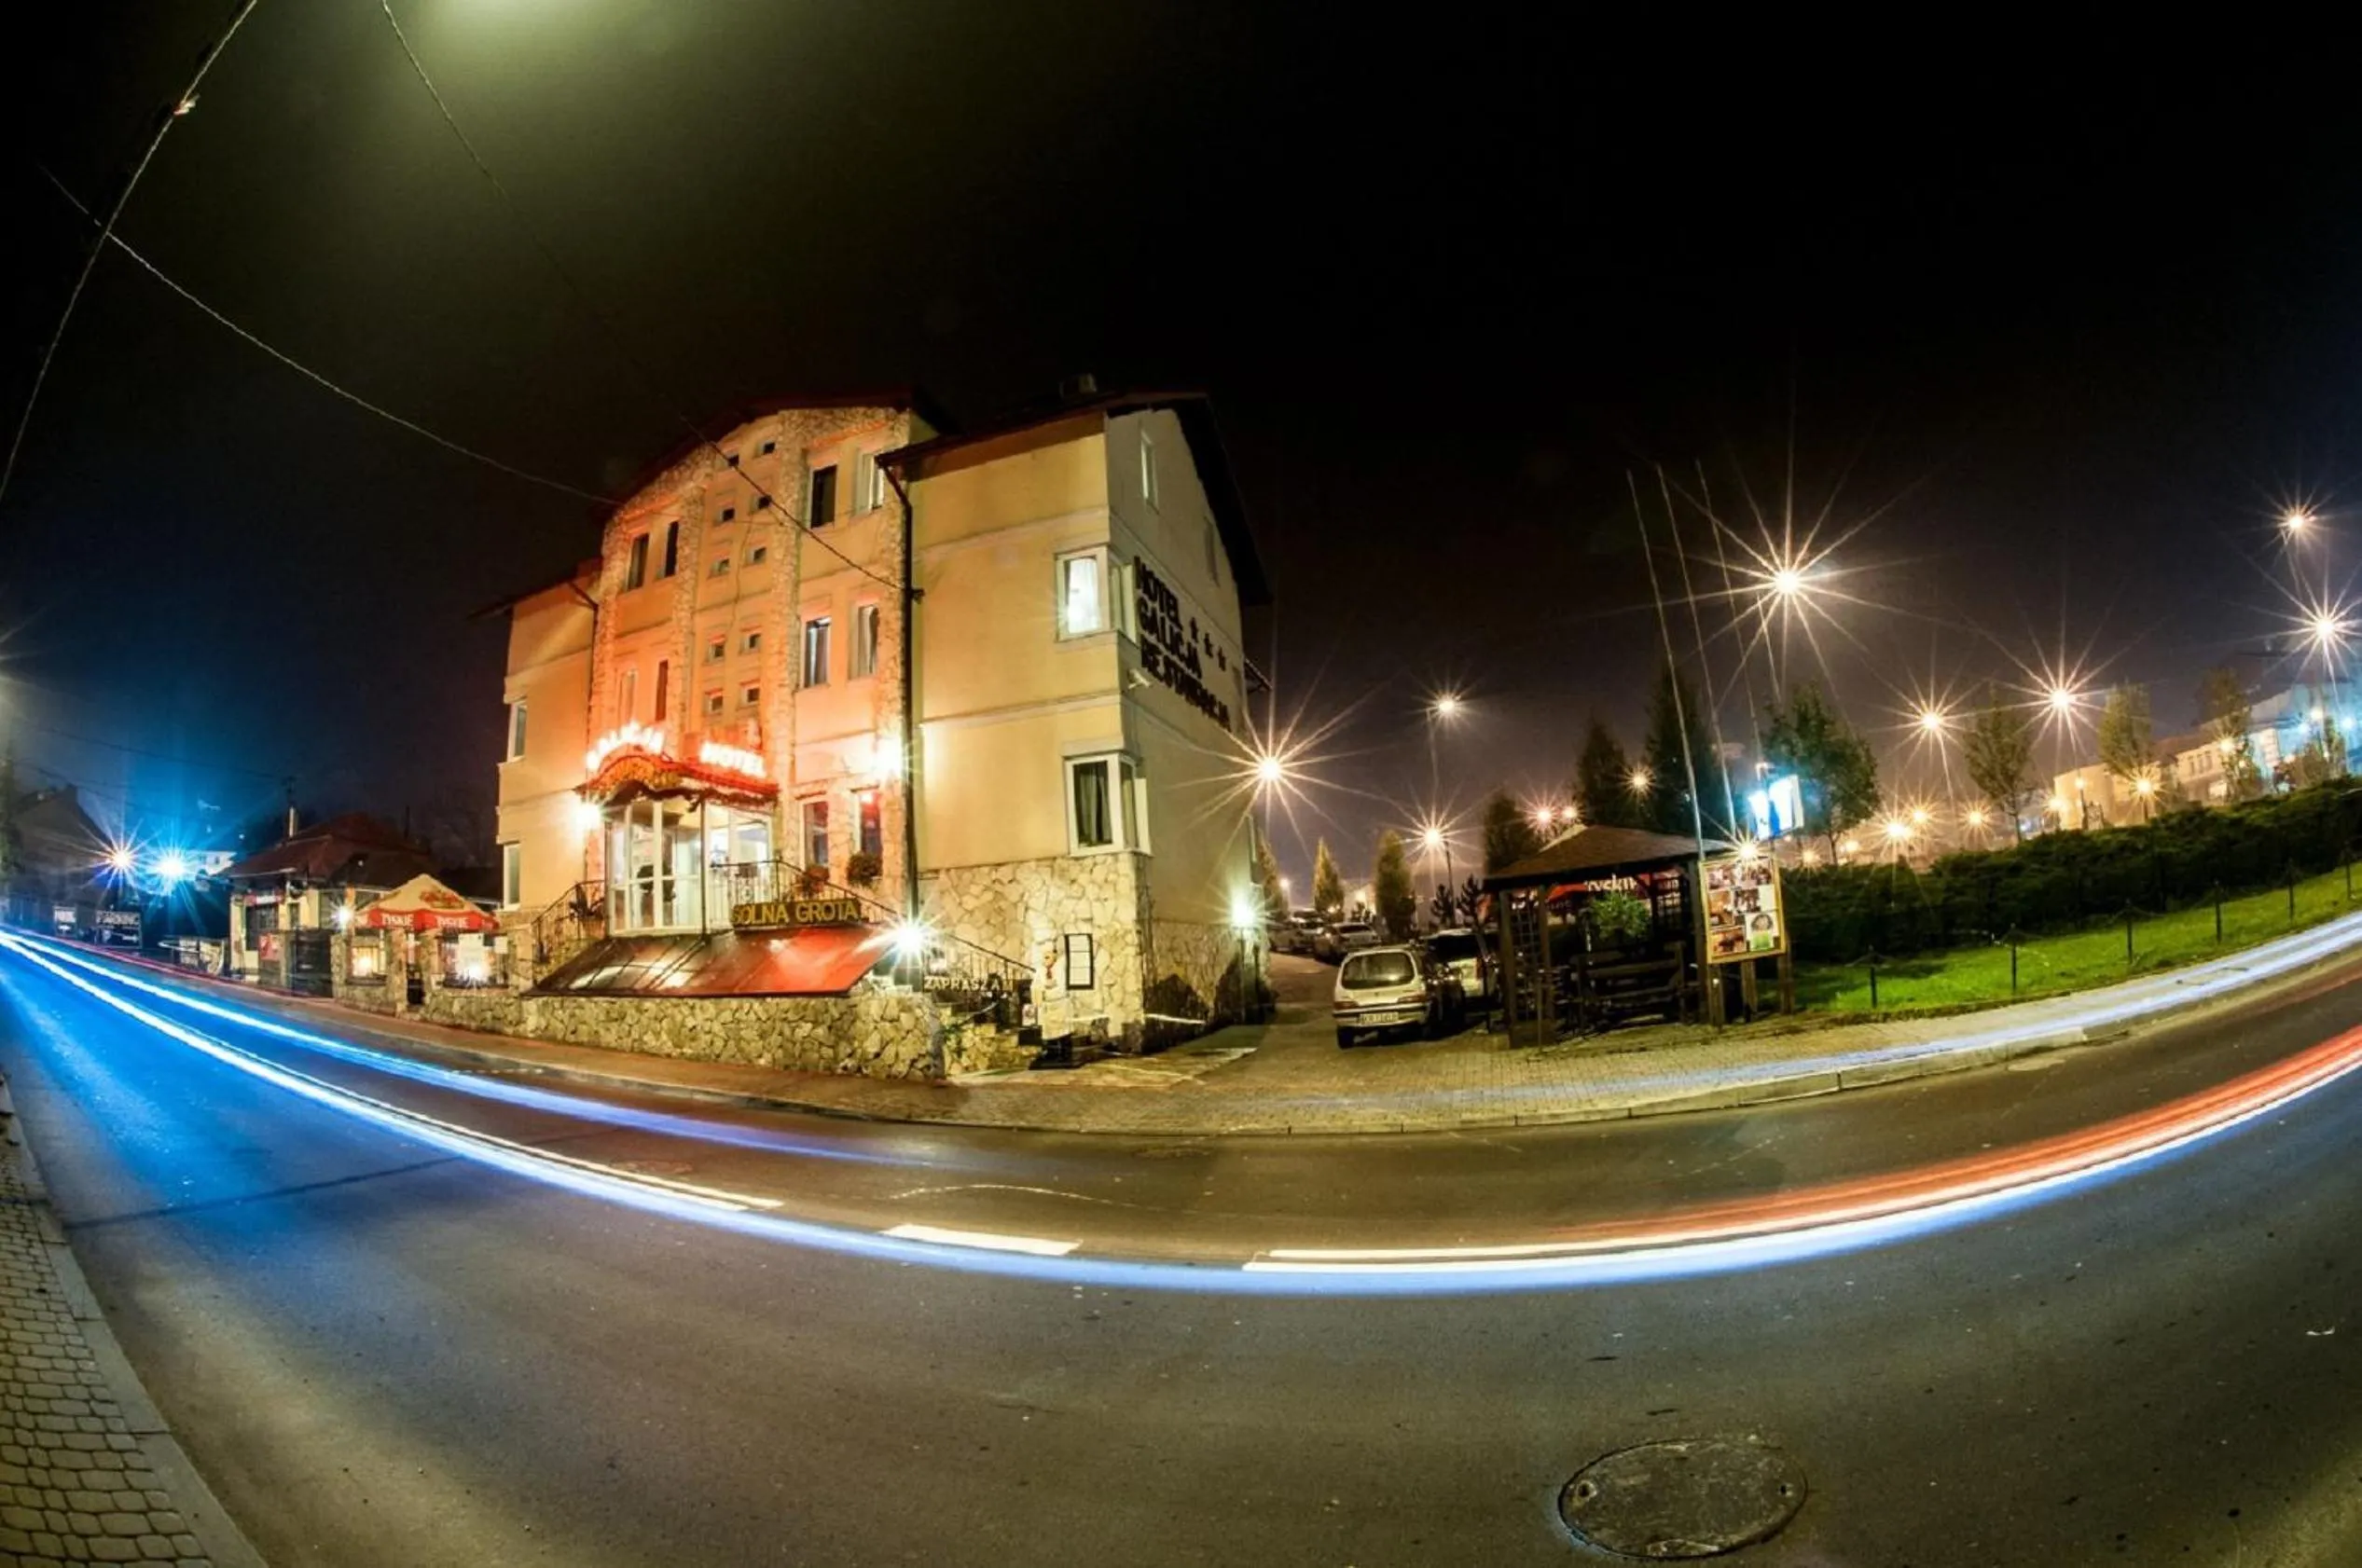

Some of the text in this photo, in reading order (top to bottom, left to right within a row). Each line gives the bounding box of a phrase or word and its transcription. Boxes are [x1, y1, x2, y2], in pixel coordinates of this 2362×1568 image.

[1134, 556, 1183, 631] HOTEL
[1138, 595, 1203, 679] GALICJA
[732, 901, 858, 926] SOLNA GROTA
